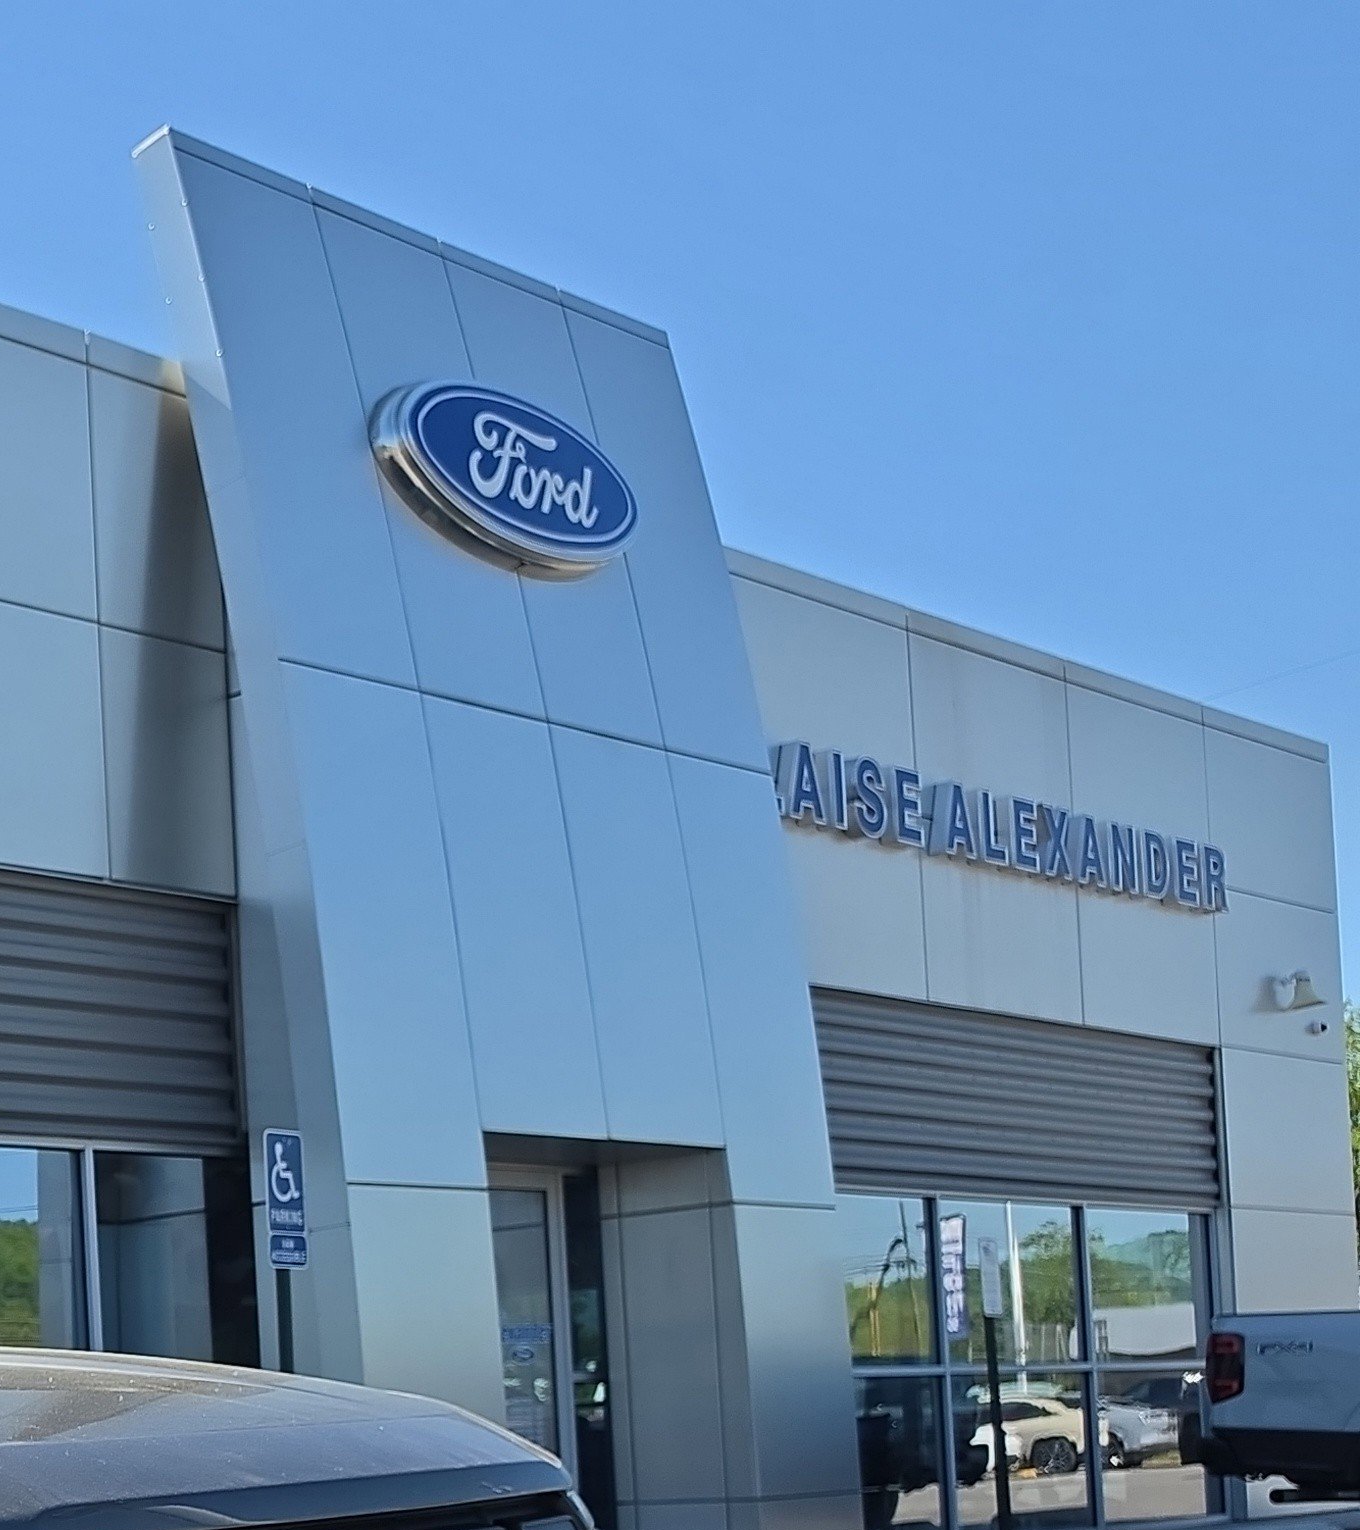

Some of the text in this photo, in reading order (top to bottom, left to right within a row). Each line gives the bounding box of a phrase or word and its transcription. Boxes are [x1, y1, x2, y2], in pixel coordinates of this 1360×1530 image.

[469, 411, 598, 528] Ford
[776, 740, 1231, 912] AISE ALEXANDER
